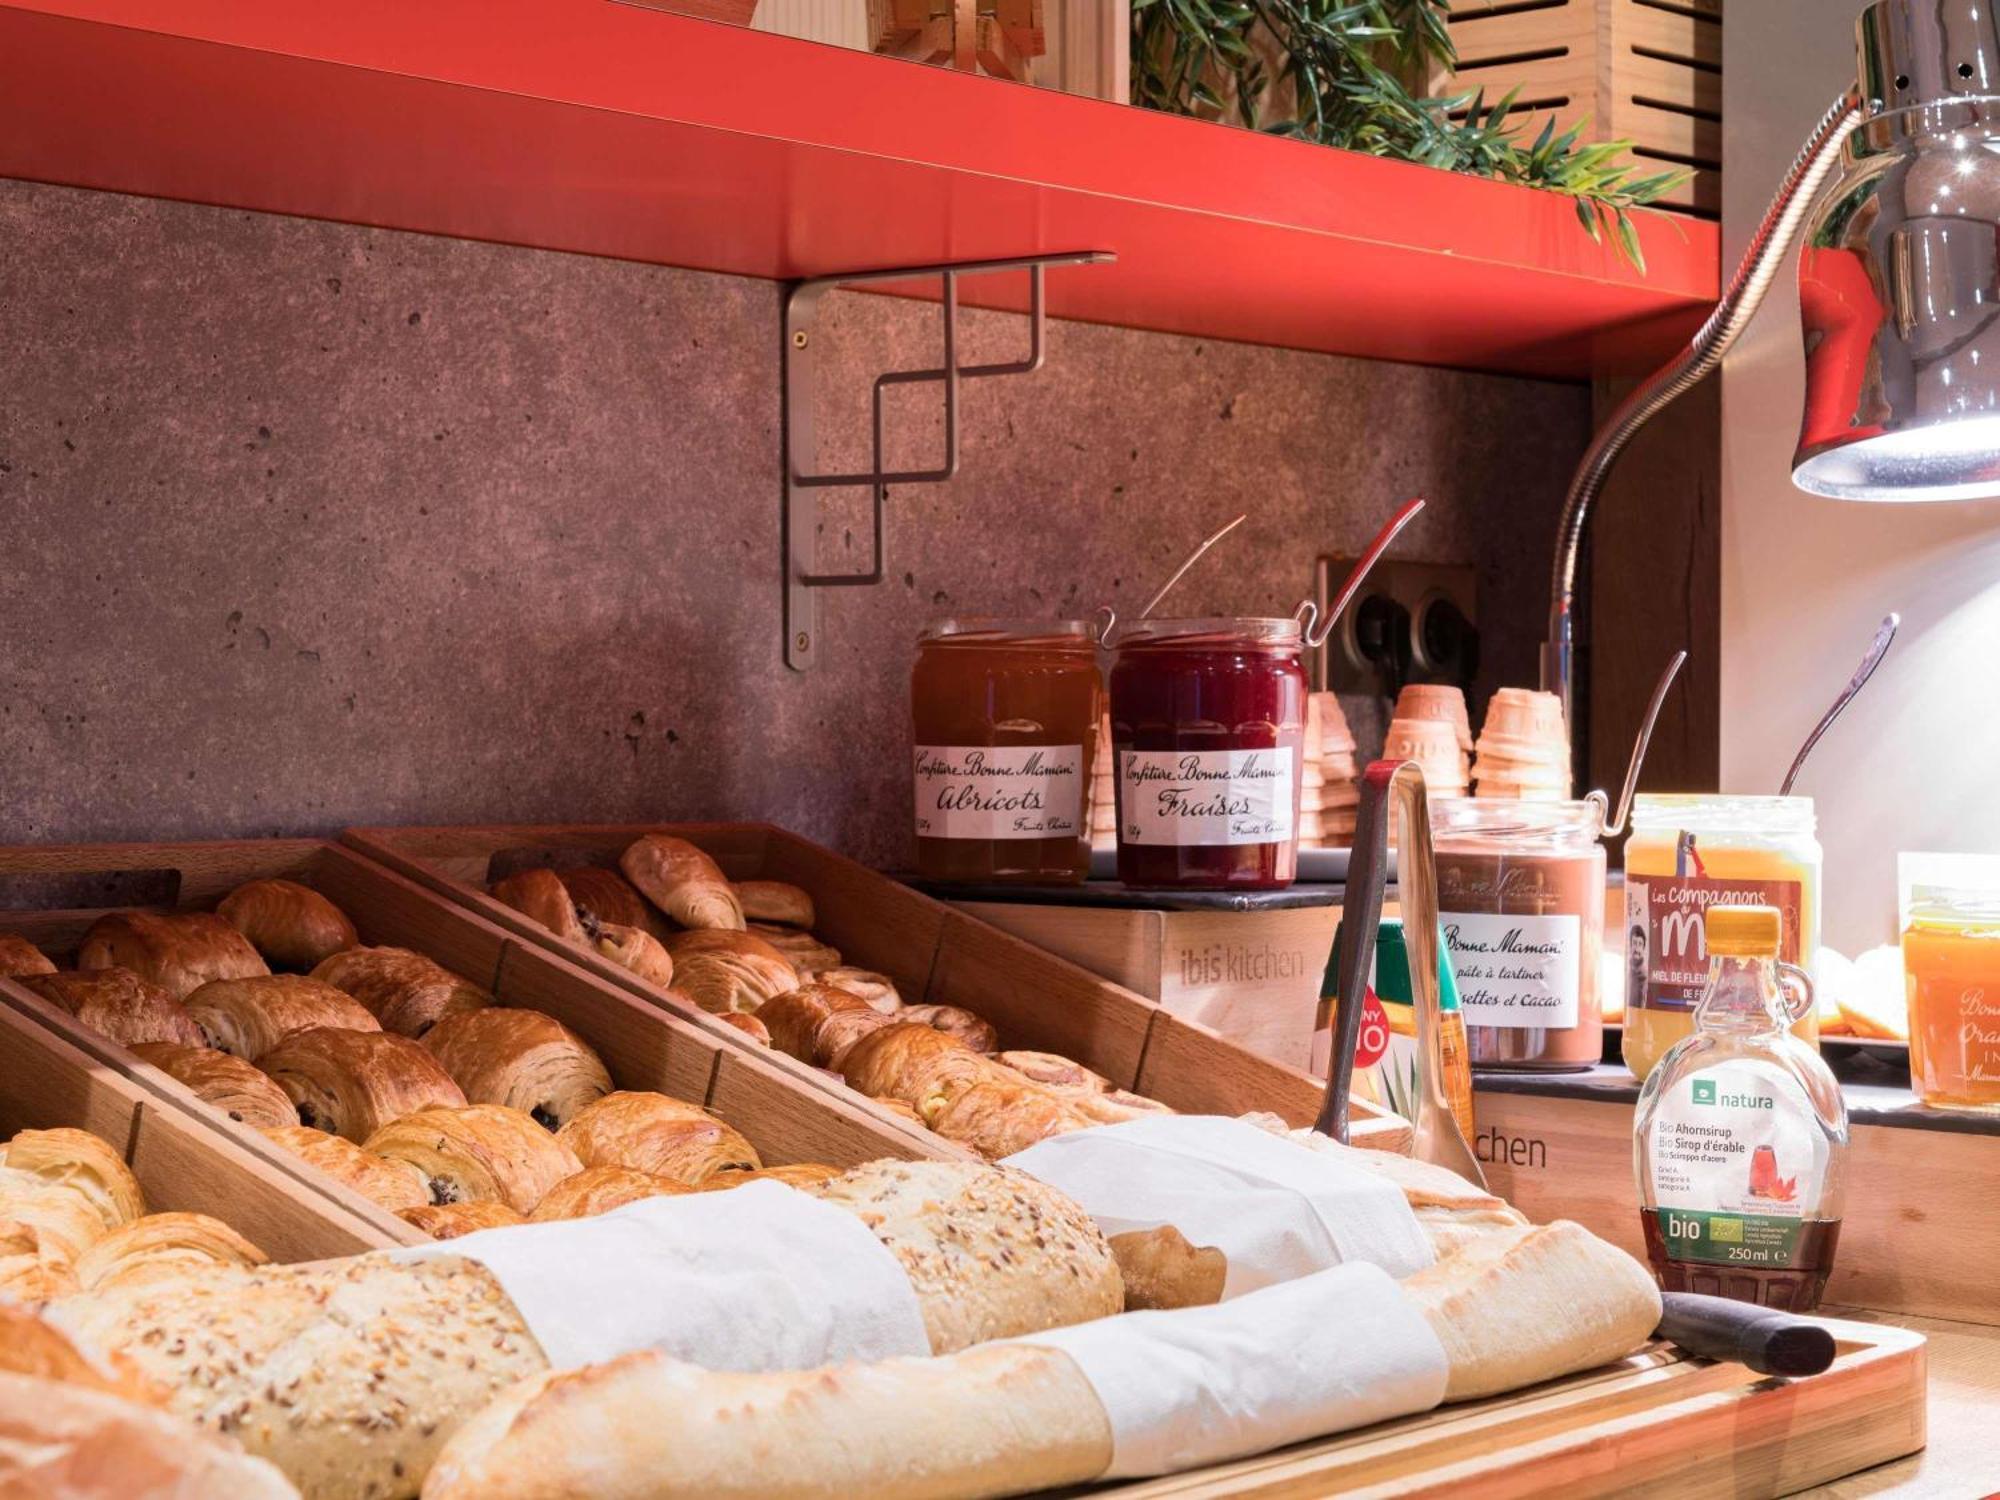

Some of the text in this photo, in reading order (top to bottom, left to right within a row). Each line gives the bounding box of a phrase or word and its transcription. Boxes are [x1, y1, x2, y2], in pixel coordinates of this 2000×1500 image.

[915, 751, 1073, 780] Confiture Bonne Maman
[1126, 755, 1176, 786] Confiture
[1178, 754, 1231, 780] Bonne
[937, 785, 1045, 811] Abricots
[1158, 788, 1252, 817] Fraises
[1443, 924, 1488, 951] Bonne
[1182, 944, 1303, 985] ibis kitchen
[1457, 965, 1544, 980] pâte à tartiner
[1671, 971, 1682, 983] DE
[1460, 989, 1499, 1005] settes
[1504, 996, 1517, 1006] et
[1720, 1093, 1773, 1109] natura
[1658, 1121, 1732, 1139] Bio Ahornsirup
[1476, 1126, 1546, 1168] chen
[1675, 1137, 1701, 1152] Sirop
[1703, 1139, 1745, 1153] d'érable
[1669, 1213, 1700, 1239] bio
[1728, 1247, 1751, 1260] 250
[1753, 1249, 1768, 1261] ml
